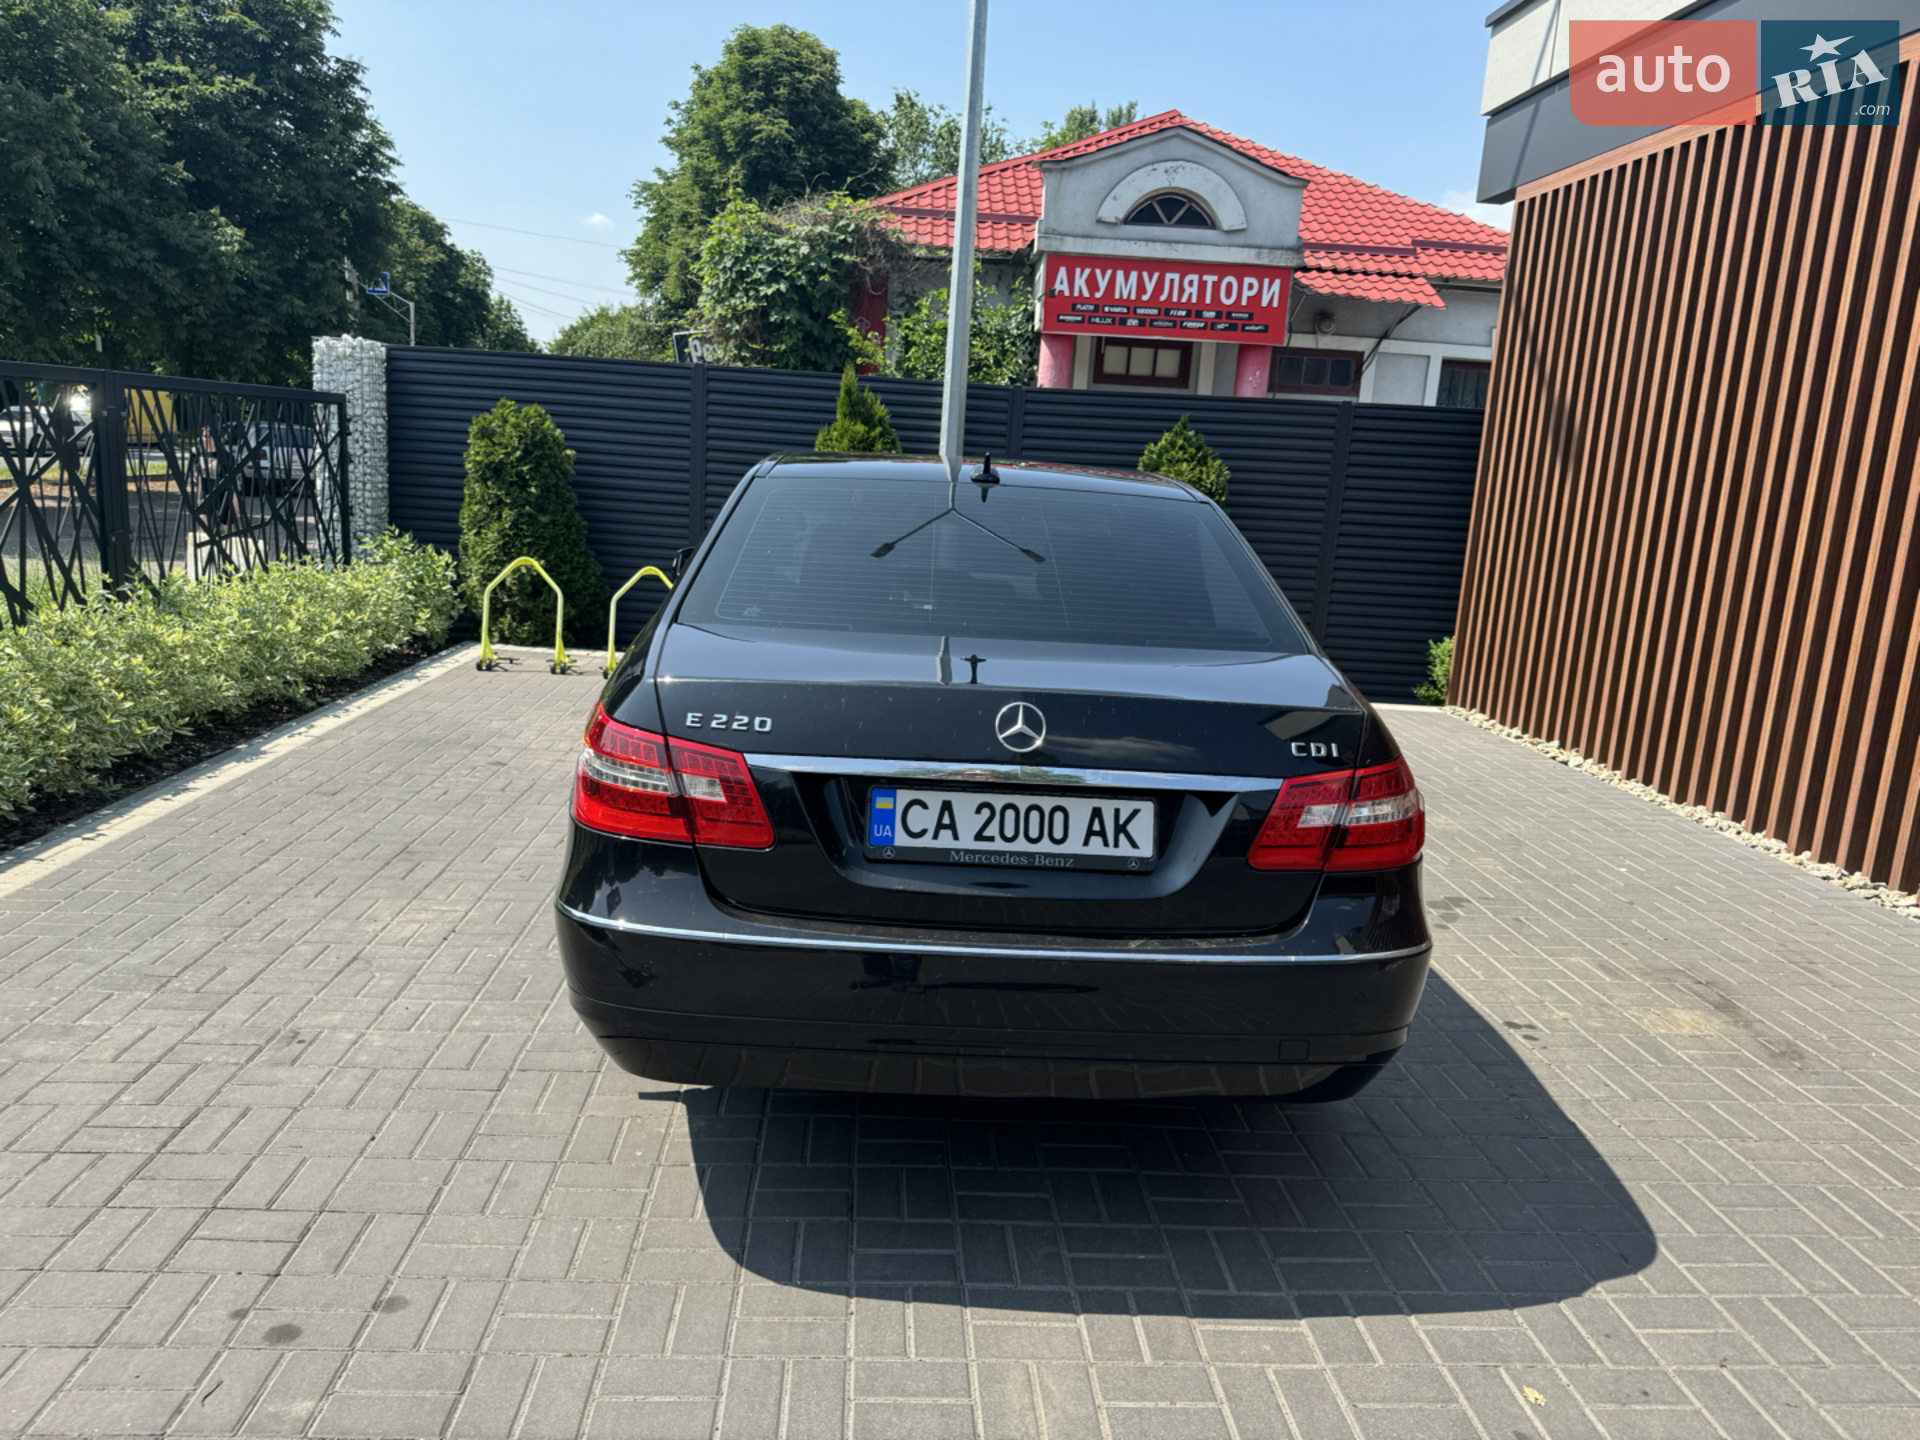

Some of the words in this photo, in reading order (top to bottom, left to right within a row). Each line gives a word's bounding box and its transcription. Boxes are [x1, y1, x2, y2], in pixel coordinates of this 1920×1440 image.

[1053, 266, 1281, 308] АКУМУЛЯТОРИ
[685, 712, 704, 728] E
[710, 713, 773, 732] 220
[1290, 742, 1339, 758] CDI
[873, 824, 893, 838] UA
[900, 798, 960, 841] CA
[973, 801, 1070, 846] 2000
[1081, 806, 1142, 850] AK
[949, 850, 1075, 868] Mercedes-Benz
